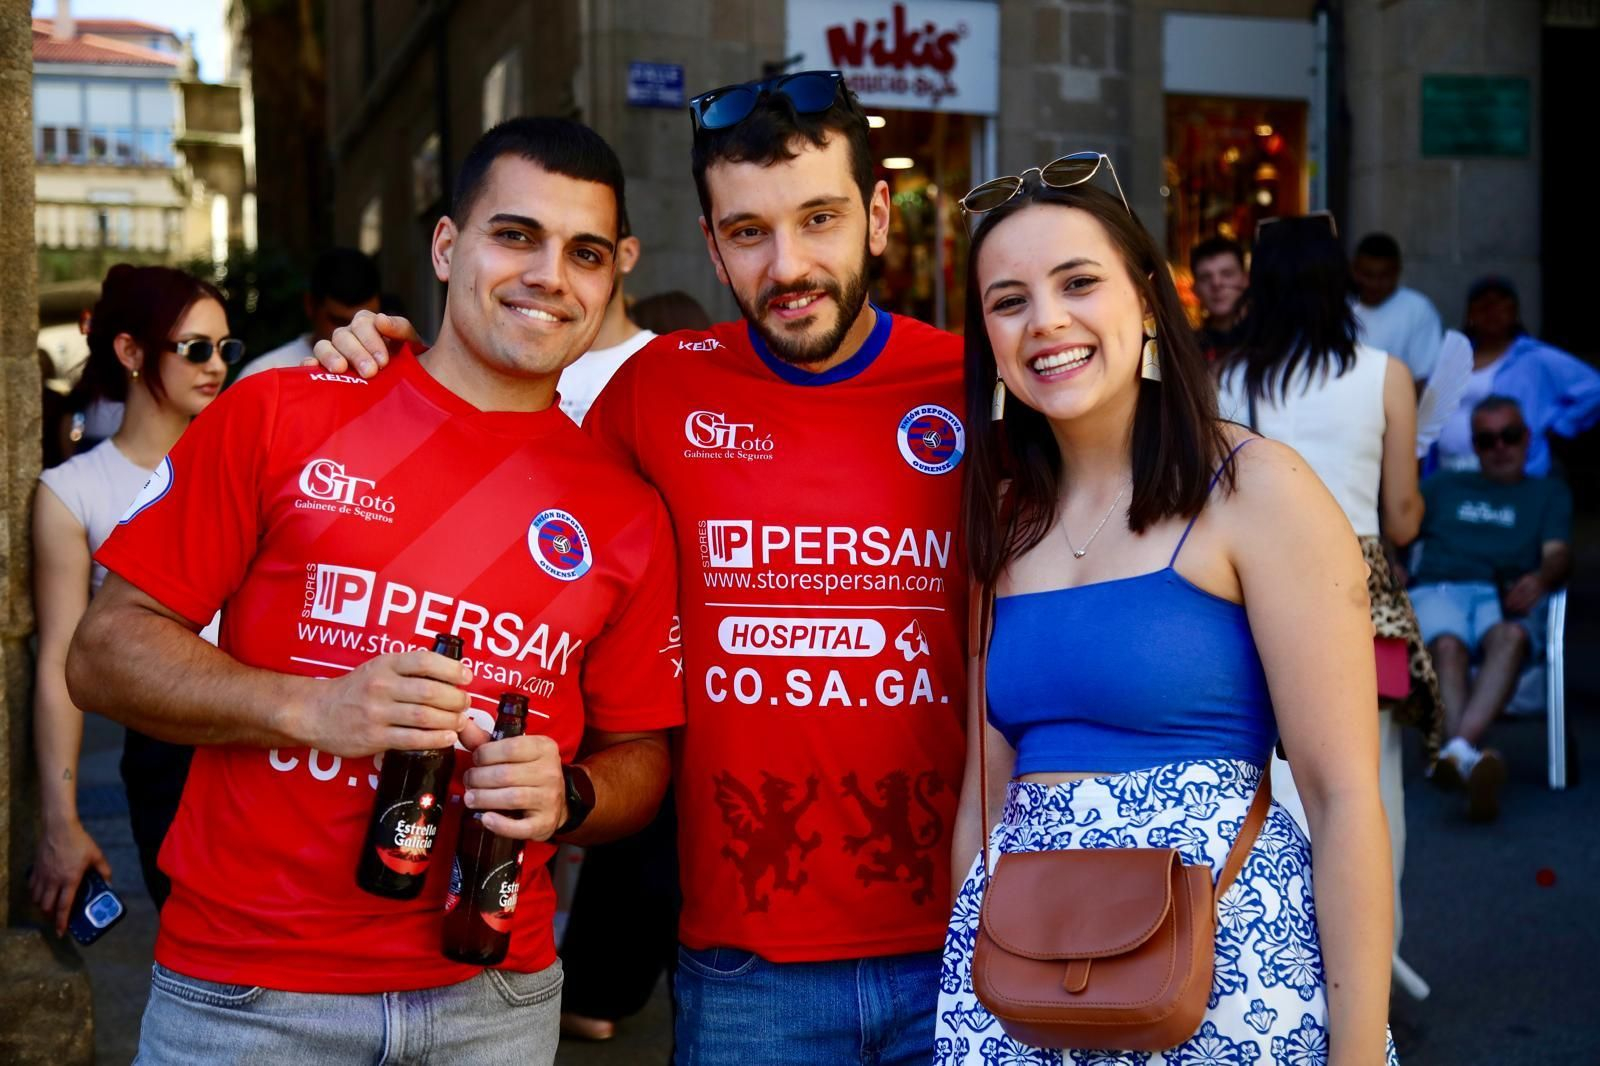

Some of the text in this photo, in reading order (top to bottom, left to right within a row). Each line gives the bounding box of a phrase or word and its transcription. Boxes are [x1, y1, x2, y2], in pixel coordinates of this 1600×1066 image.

[921, 408, 961, 432] DEPORTIVA
[684, 449, 774, 462] Gabinete de Seguros
[912, 460, 952, 472] OURENSE
[294, 499, 394, 524] Gabinete de Seguros
[555, 511, 589, 548] DEPORTIVA
[698, 520, 709, 568] STORES
[761, 525, 951, 569] PERSAN
[539, 560, 577, 578] OURENSE
[703, 569, 945, 596] www.storespersan.com
[301, 563, 317, 619] STORES
[378, 581, 582, 675] PERSAN
[731, 623, 871, 650] HOSPITAL
[705, 665, 949, 707] CO.SA.GA.
[394, 819, 437, 837] Estrella
[394, 832, 433, 849] Galicia
